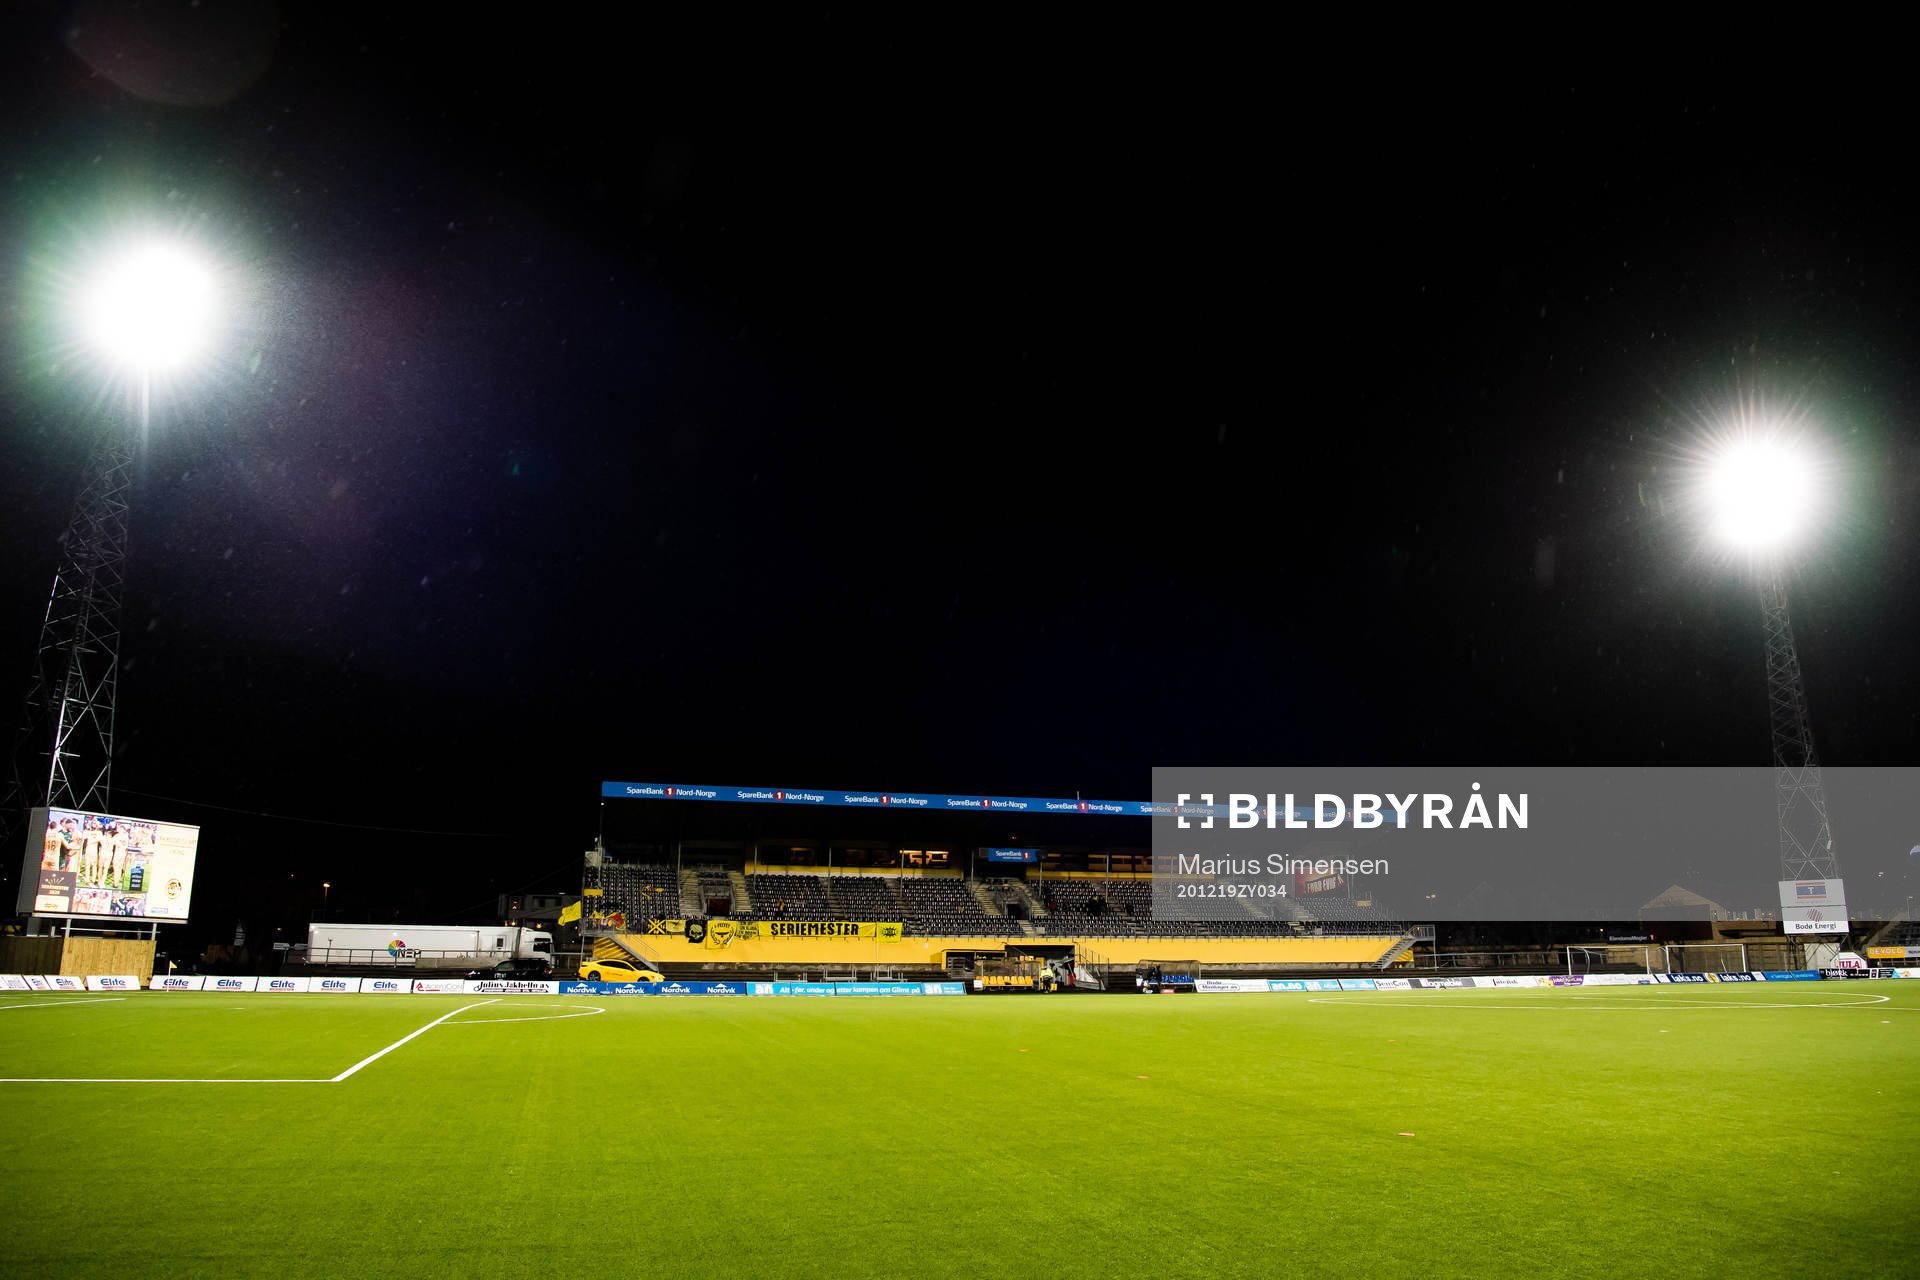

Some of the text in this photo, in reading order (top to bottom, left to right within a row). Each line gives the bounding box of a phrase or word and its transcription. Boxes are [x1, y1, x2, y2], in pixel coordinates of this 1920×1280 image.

[626, 786, 664, 796] SpareBank
[676, 788, 717, 798] Nord-Norge
[737, 790, 774, 800] SpareBank
[785, 793, 824, 802] Nord-Norge
[844, 795, 879, 804] SpareBank
[890, 797, 928, 805] Nord-Norge
[947, 798, 981, 807] SpareBank
[991, 800, 1028, 809] Nord-Norge
[1046, 802, 1078, 810] SpareBank
[1088, 804, 1123, 812] Nord-Norge
[770, 923, 859, 936] SERIEMESTER
[1814, 922, 1837, 931] Energi
[397, 948, 422, 958] NEP
[1720, 973, 1752, 982] laks.no
[1825, 969, 1849, 978] bjørk
[100, 978, 126, 986] Elite
[163, 978, 189, 986] Elite
[1671, 974, 1704, 982] laks.no
[217, 979, 243, 987] Elite
[270, 980, 296, 988] Elite
[321, 980, 347, 988] Elite
[567, 986, 597, 994] Nordvik
[615, 986, 644, 994] Nordvik
[661, 986, 691, 994] Nordvik
[707, 986, 736, 994] Nordvik
